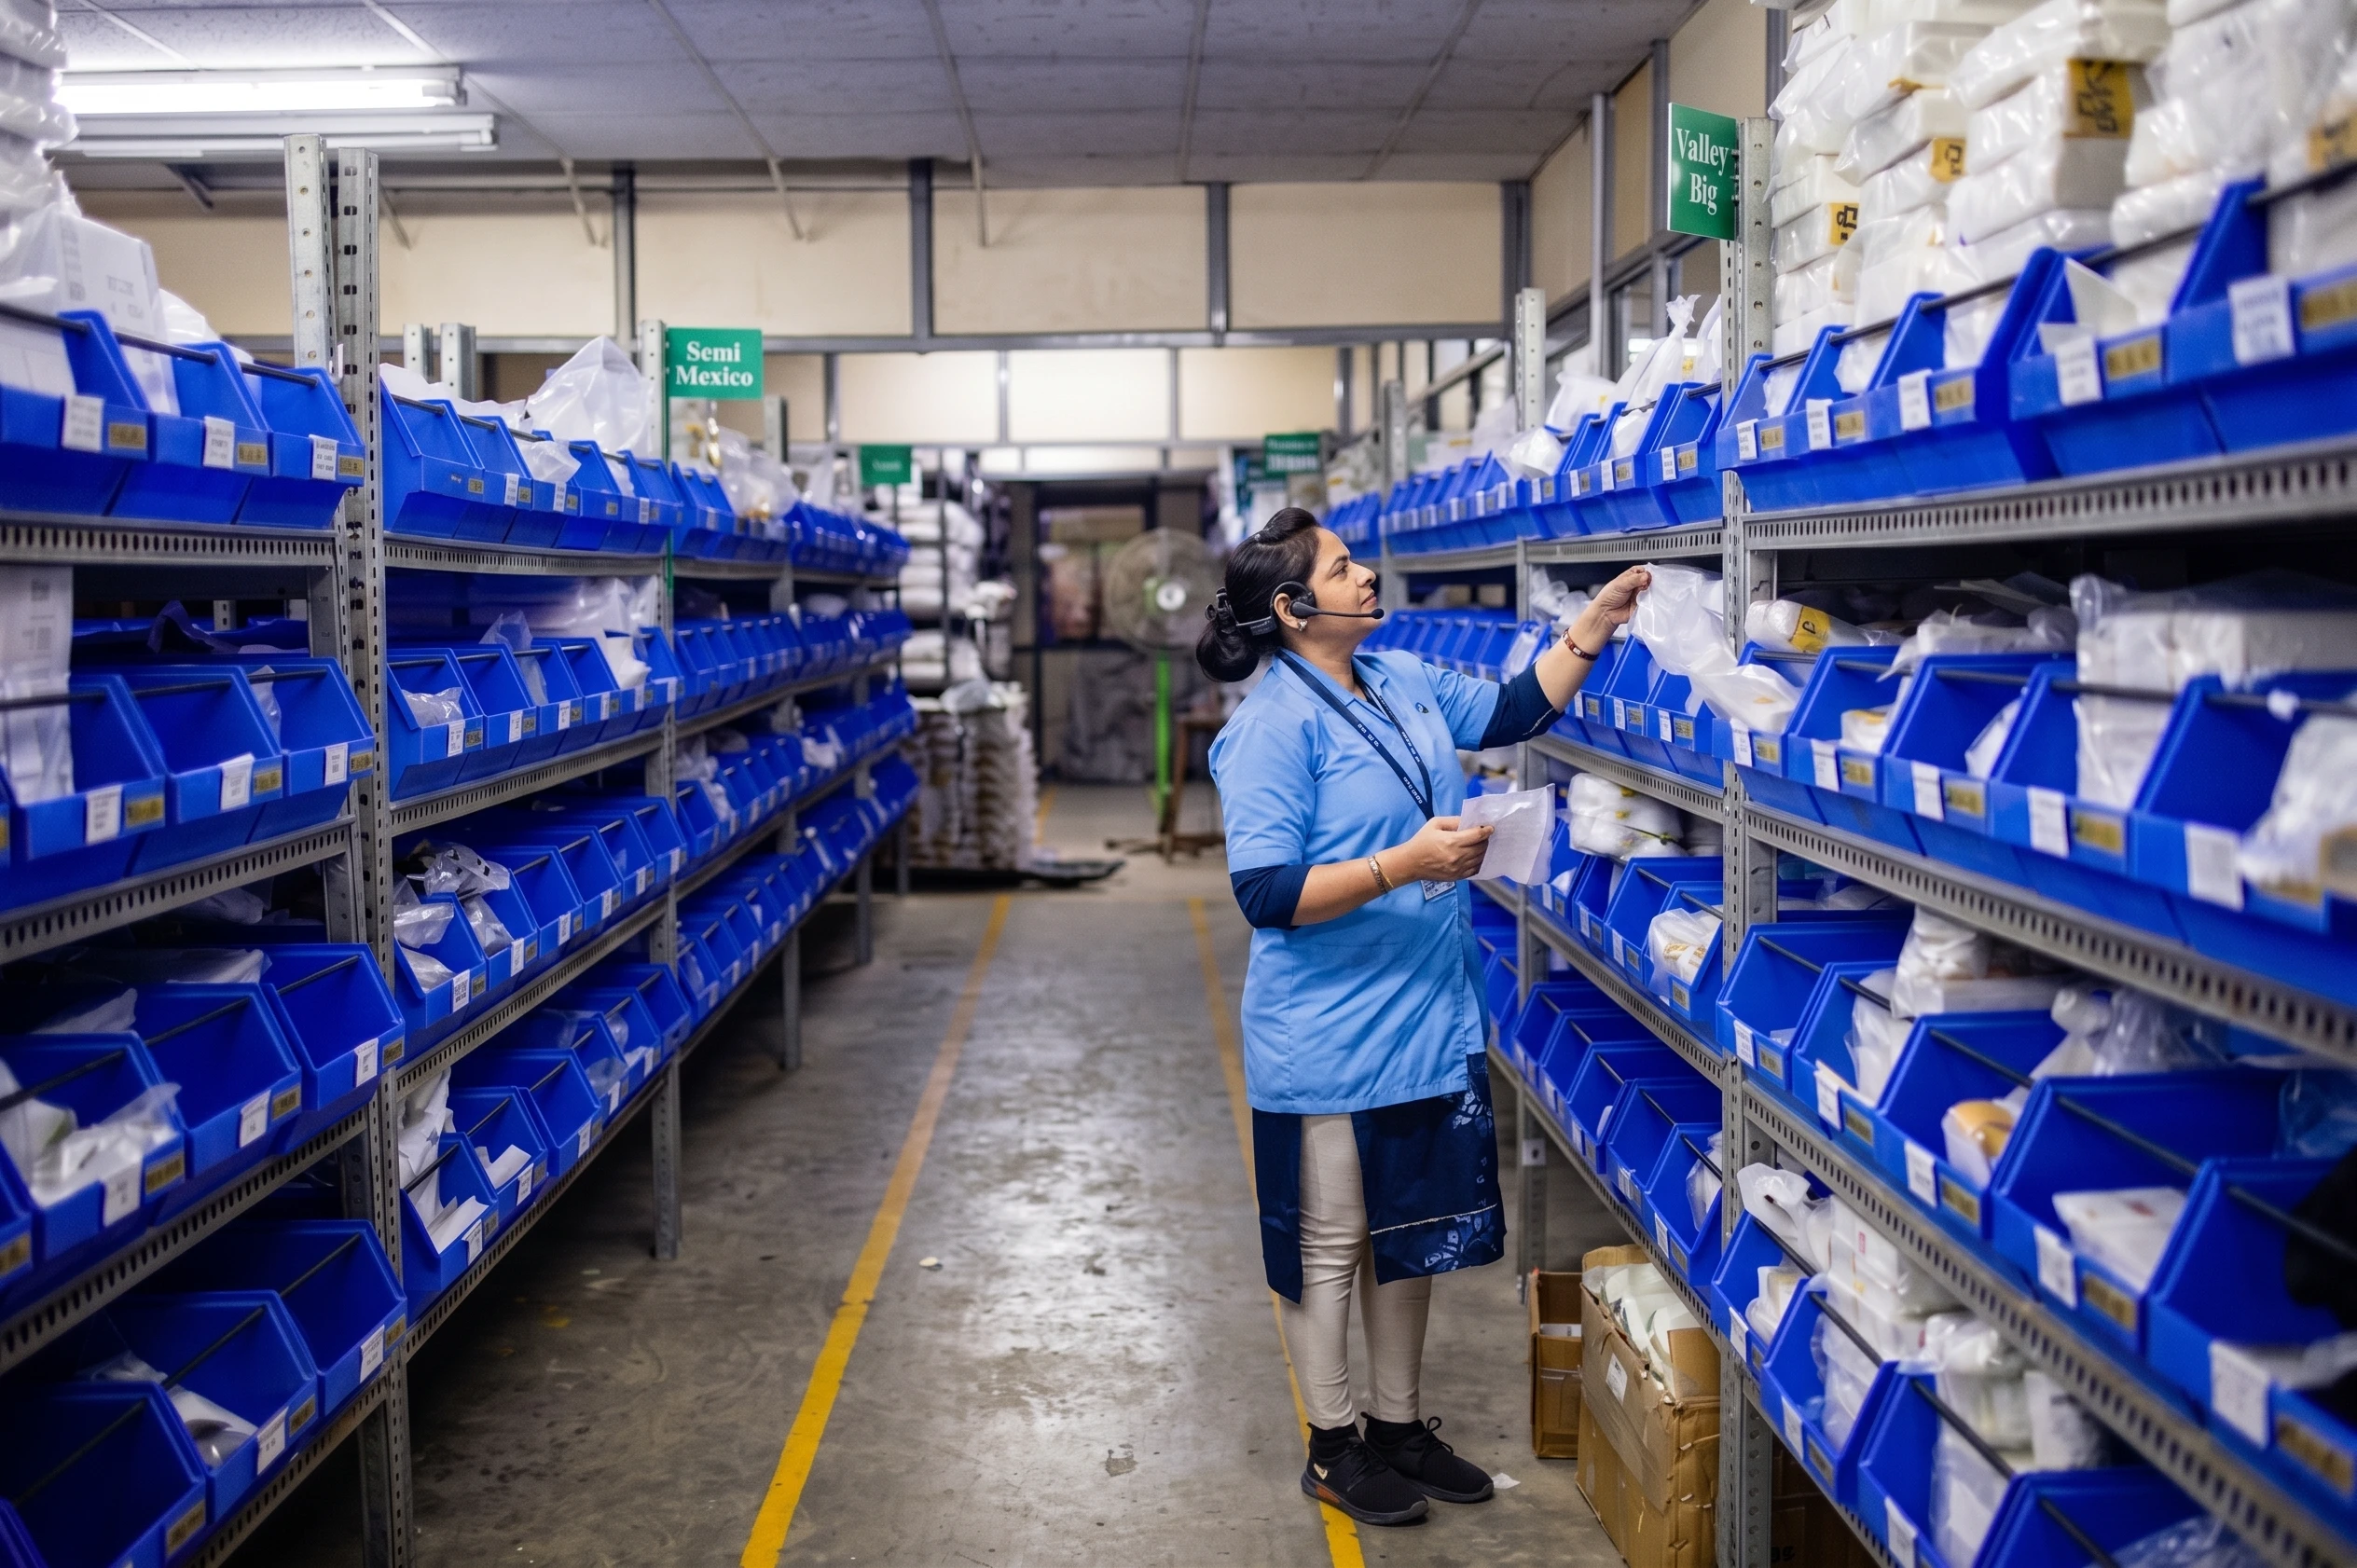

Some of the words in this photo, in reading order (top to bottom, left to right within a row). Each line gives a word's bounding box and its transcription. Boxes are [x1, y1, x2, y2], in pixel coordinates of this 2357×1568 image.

[1675, 128, 1730, 176] Valley
[1689, 172, 1718, 215] Big
[686, 340, 741, 362] Semi
[676, 364, 753, 387] Mexico
